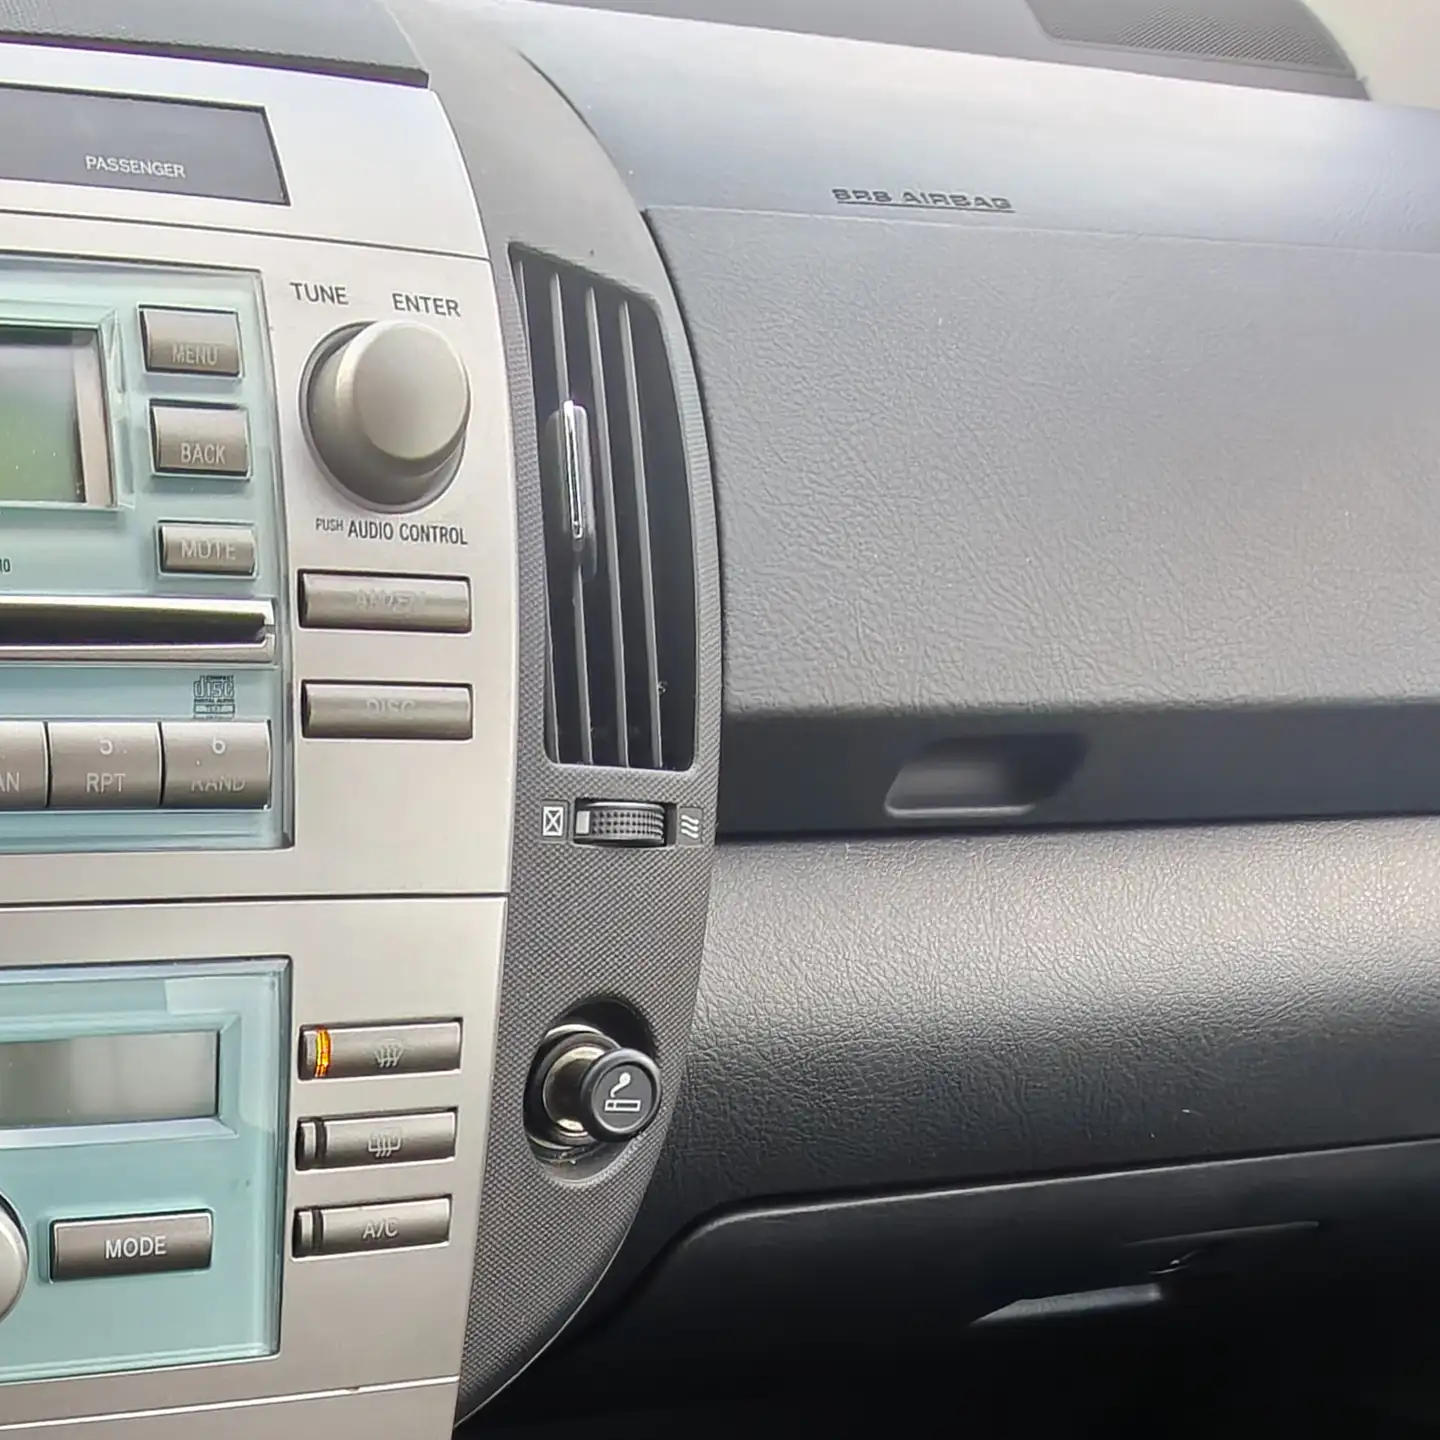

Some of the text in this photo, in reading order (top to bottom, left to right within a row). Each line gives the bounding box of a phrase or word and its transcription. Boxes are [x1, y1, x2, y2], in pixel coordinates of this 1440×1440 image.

[84, 154, 186, 179] PASSENGER
[900, 190, 1012, 211] AIRBAG
[289, 281, 350, 306] TUNE
[391, 292, 462, 318] ENTER
[171, 343, 219, 366] MENU
[180, 442, 227, 467] BACK
[315, 517, 468, 546] PUSH AUDIO CONTROL
[180, 538, 236, 562] MUTE
[210, 735, 227, 755] 6
[86, 771, 127, 794] RPT
[362, 1219, 400, 1241] A/C
[104, 1234, 169, 1260] MODE
